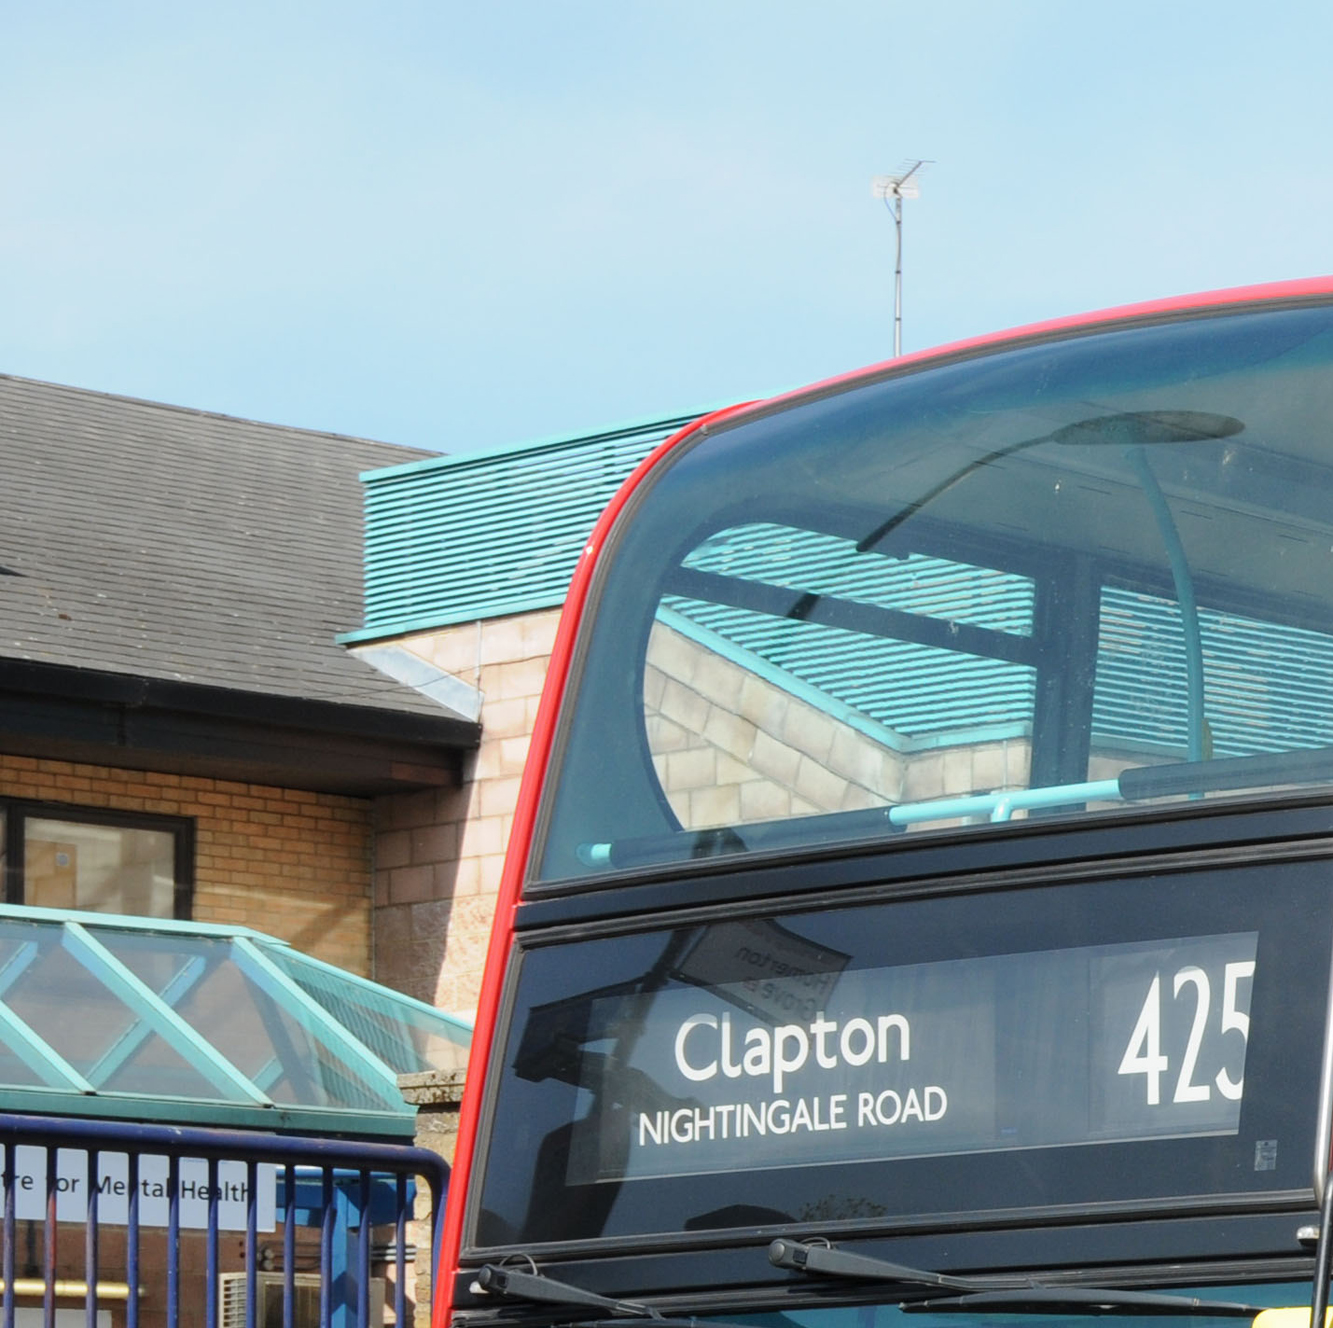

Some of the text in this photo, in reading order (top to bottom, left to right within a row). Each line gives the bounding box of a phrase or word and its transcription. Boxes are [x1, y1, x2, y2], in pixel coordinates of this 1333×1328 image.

[675, 1011, 910, 1093] Clapton
[1117, 960, 1257, 1106] 425
[639, 1086, 948, 1146] NIGHTINGALE ROAD
[96, 1175, 170, 1200] Metal
